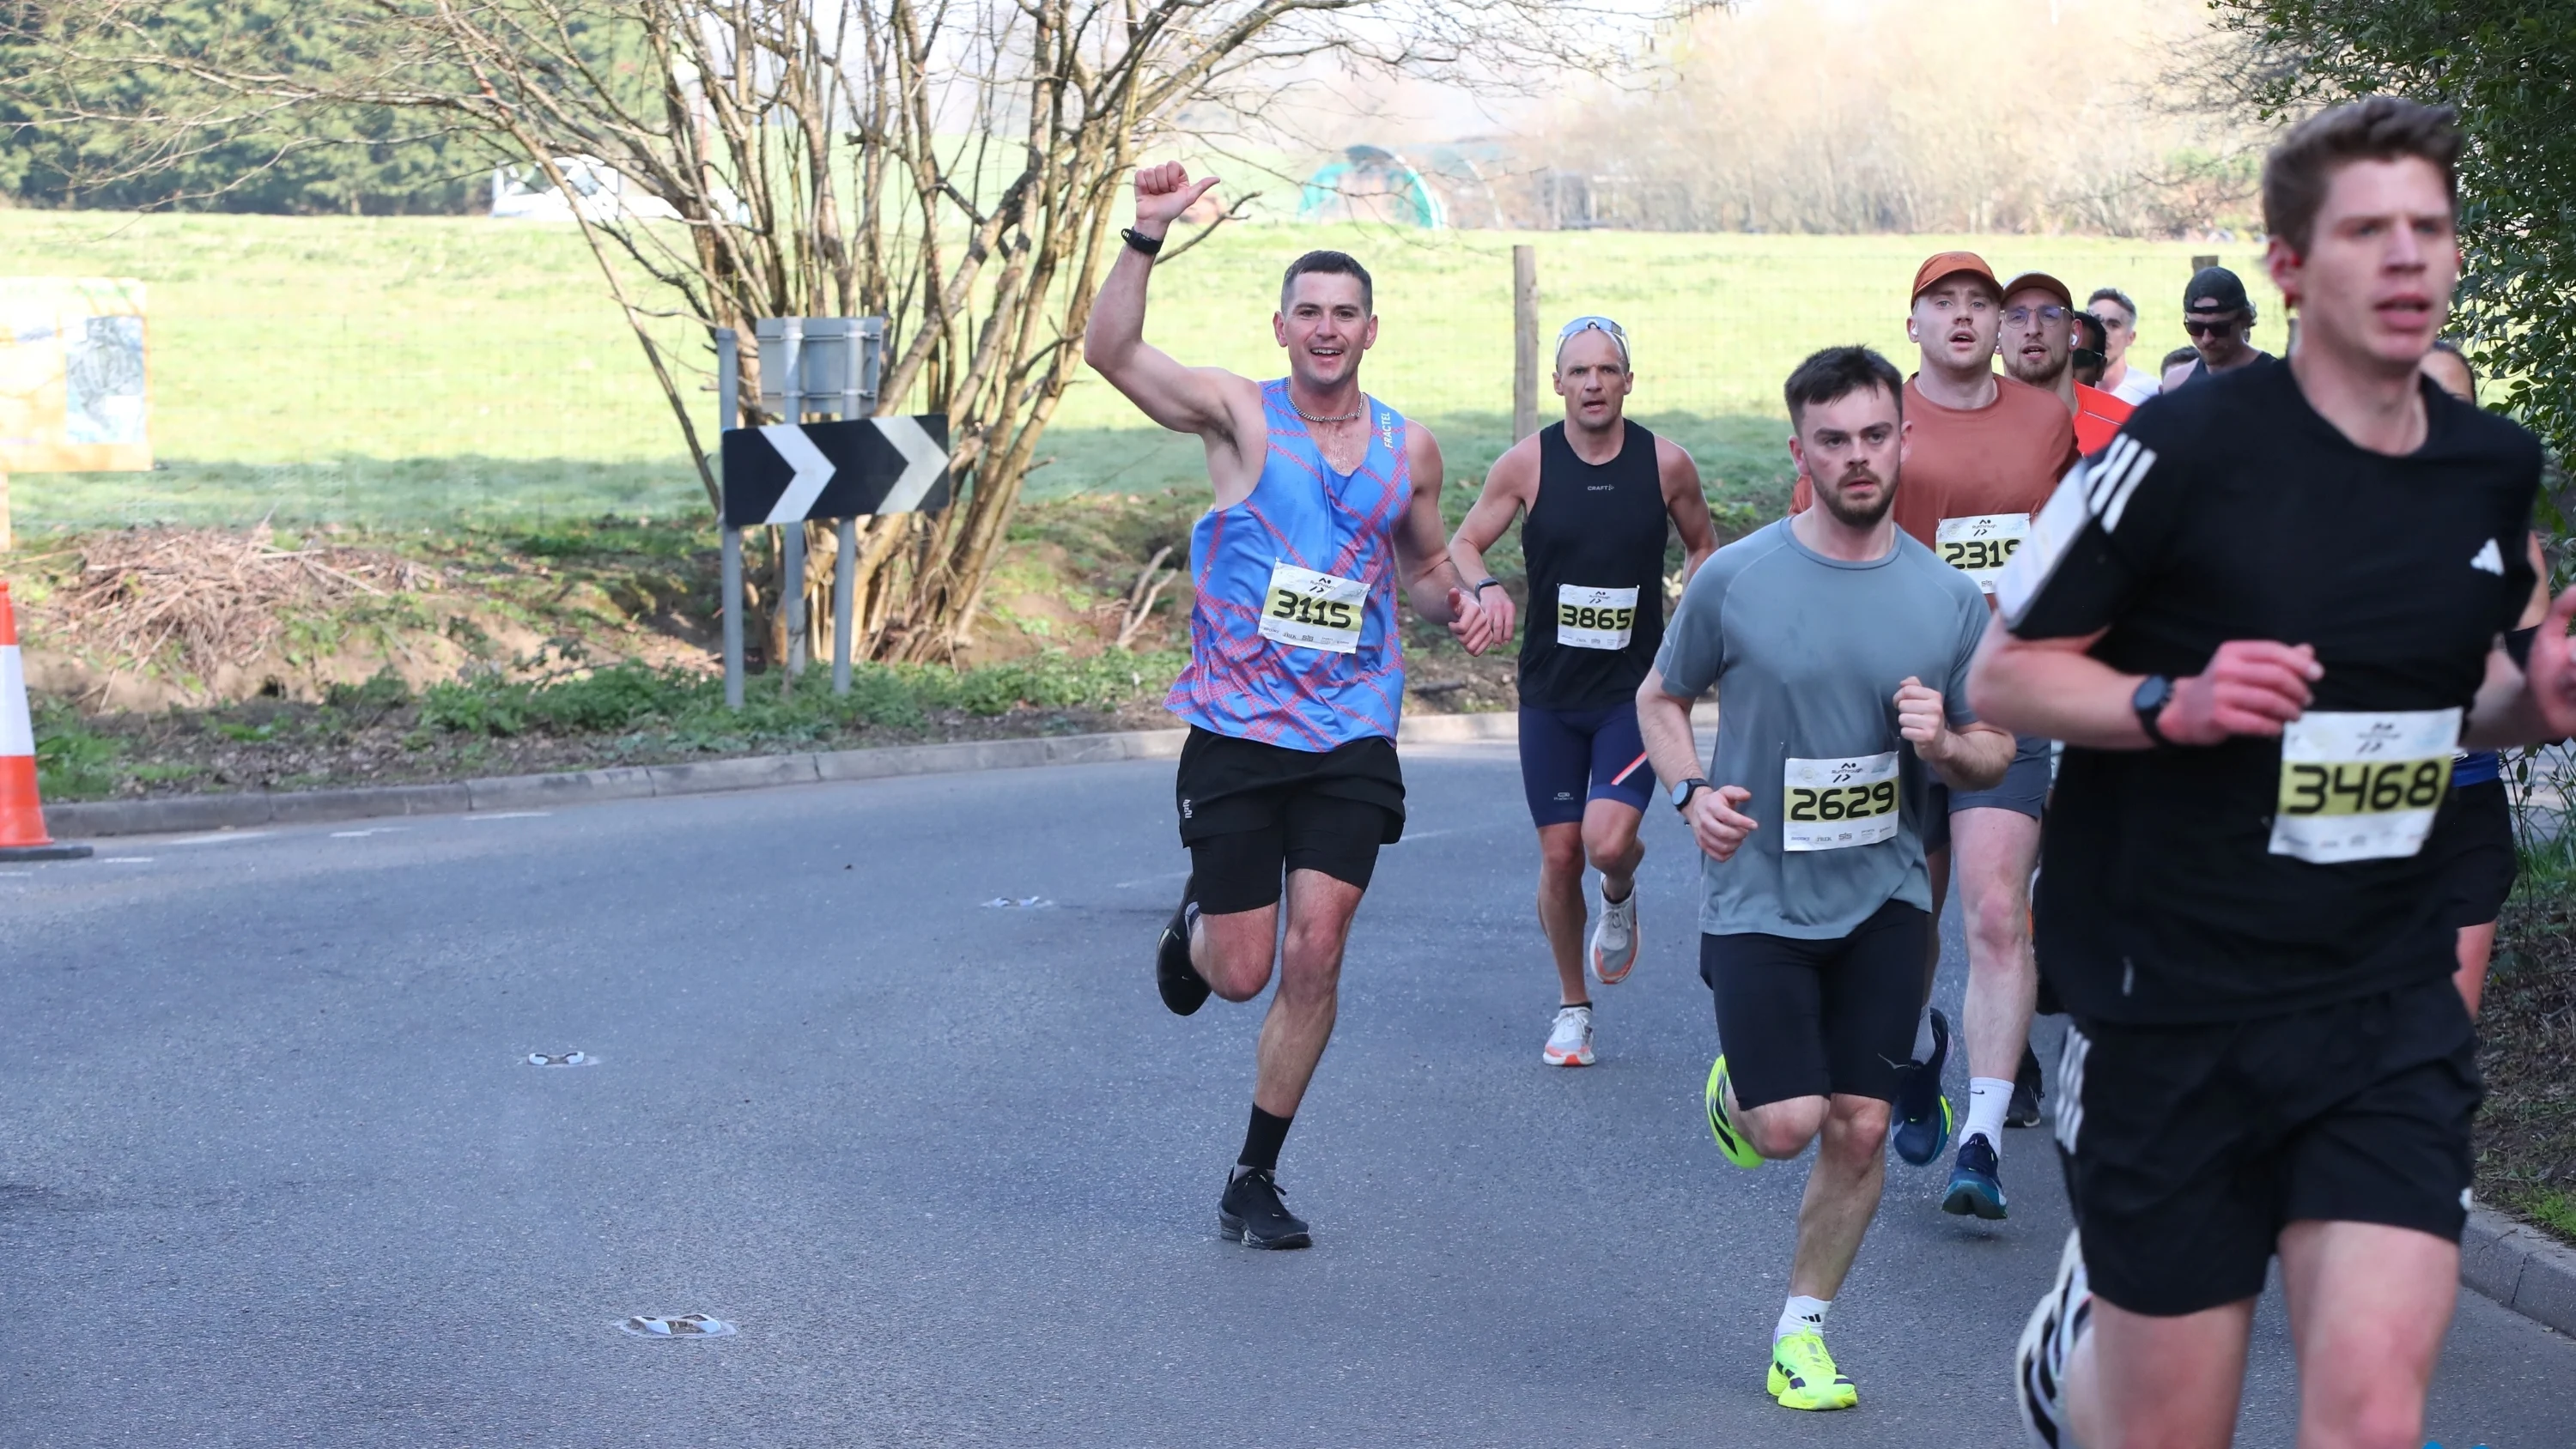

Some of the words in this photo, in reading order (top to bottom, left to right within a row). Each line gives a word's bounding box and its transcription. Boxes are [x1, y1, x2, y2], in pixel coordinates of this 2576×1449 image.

[1380, 412, 1394, 449] FRACTEL
[1273, 589, 1352, 628] 3115
[1561, 603, 1632, 630] 3865
[1790, 780, 1894, 821] 2629
[2287, 760, 2440, 814] 3468
